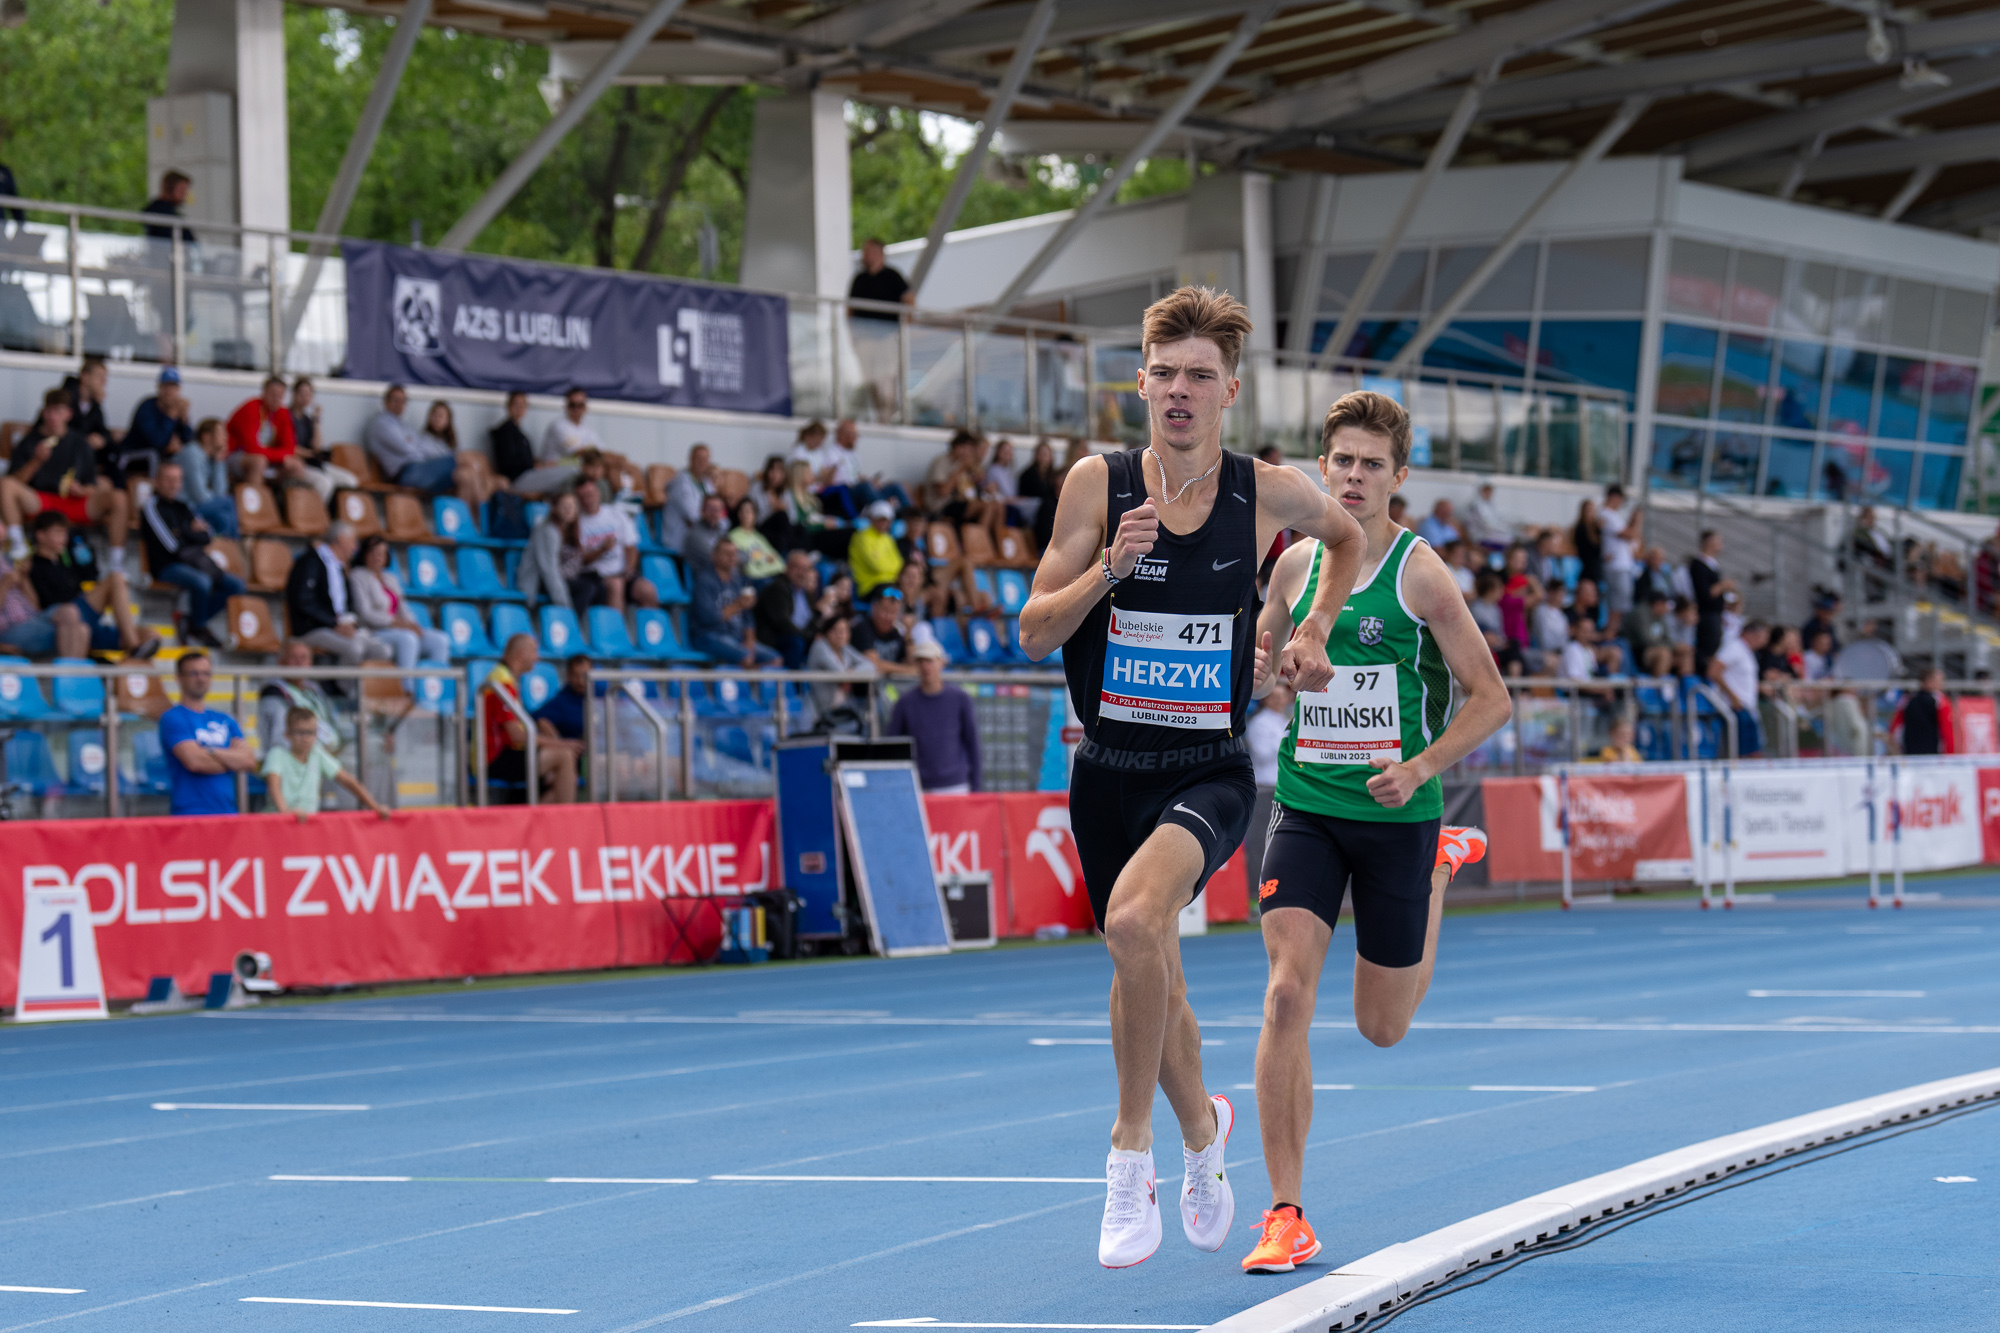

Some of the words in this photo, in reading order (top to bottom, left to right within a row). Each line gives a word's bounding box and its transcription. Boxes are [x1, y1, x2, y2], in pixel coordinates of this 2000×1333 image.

[453, 304, 500, 342] AZS
[504, 309, 592, 350] LUBLIN
[1134, 564, 1168, 577] TEAM
[1178, 622, 1222, 645] 471
[1112, 656, 1222, 689] HERZYK
[1353, 671, 1380, 691] 97
[1108, 695, 1118, 704] 77.
[1120, 698, 1137, 707] PZLA
[1138, 700, 1184, 711] Mistrzostwa
[1185, 704, 1207, 712] Polski
[1131, 710, 1169, 722] LUBLIN
[1170, 715, 1197, 725] 2023
[1303, 702, 1394, 729] KITLIŃSKI
[1100, 747, 1158, 770] NIKE
[1161, 743, 1214, 769] PRO
[1320, 752, 1347, 760] LUBLIN
[1348, 752, 1371, 760] 2023
[1359, 741, 1379, 749] Polski
[22, 856, 266, 927] POLSKI
[281, 849, 559, 922] ZWIĄZEK
[568, 842, 770, 903] LEKKIEJ
[40, 910, 75, 989] 1
